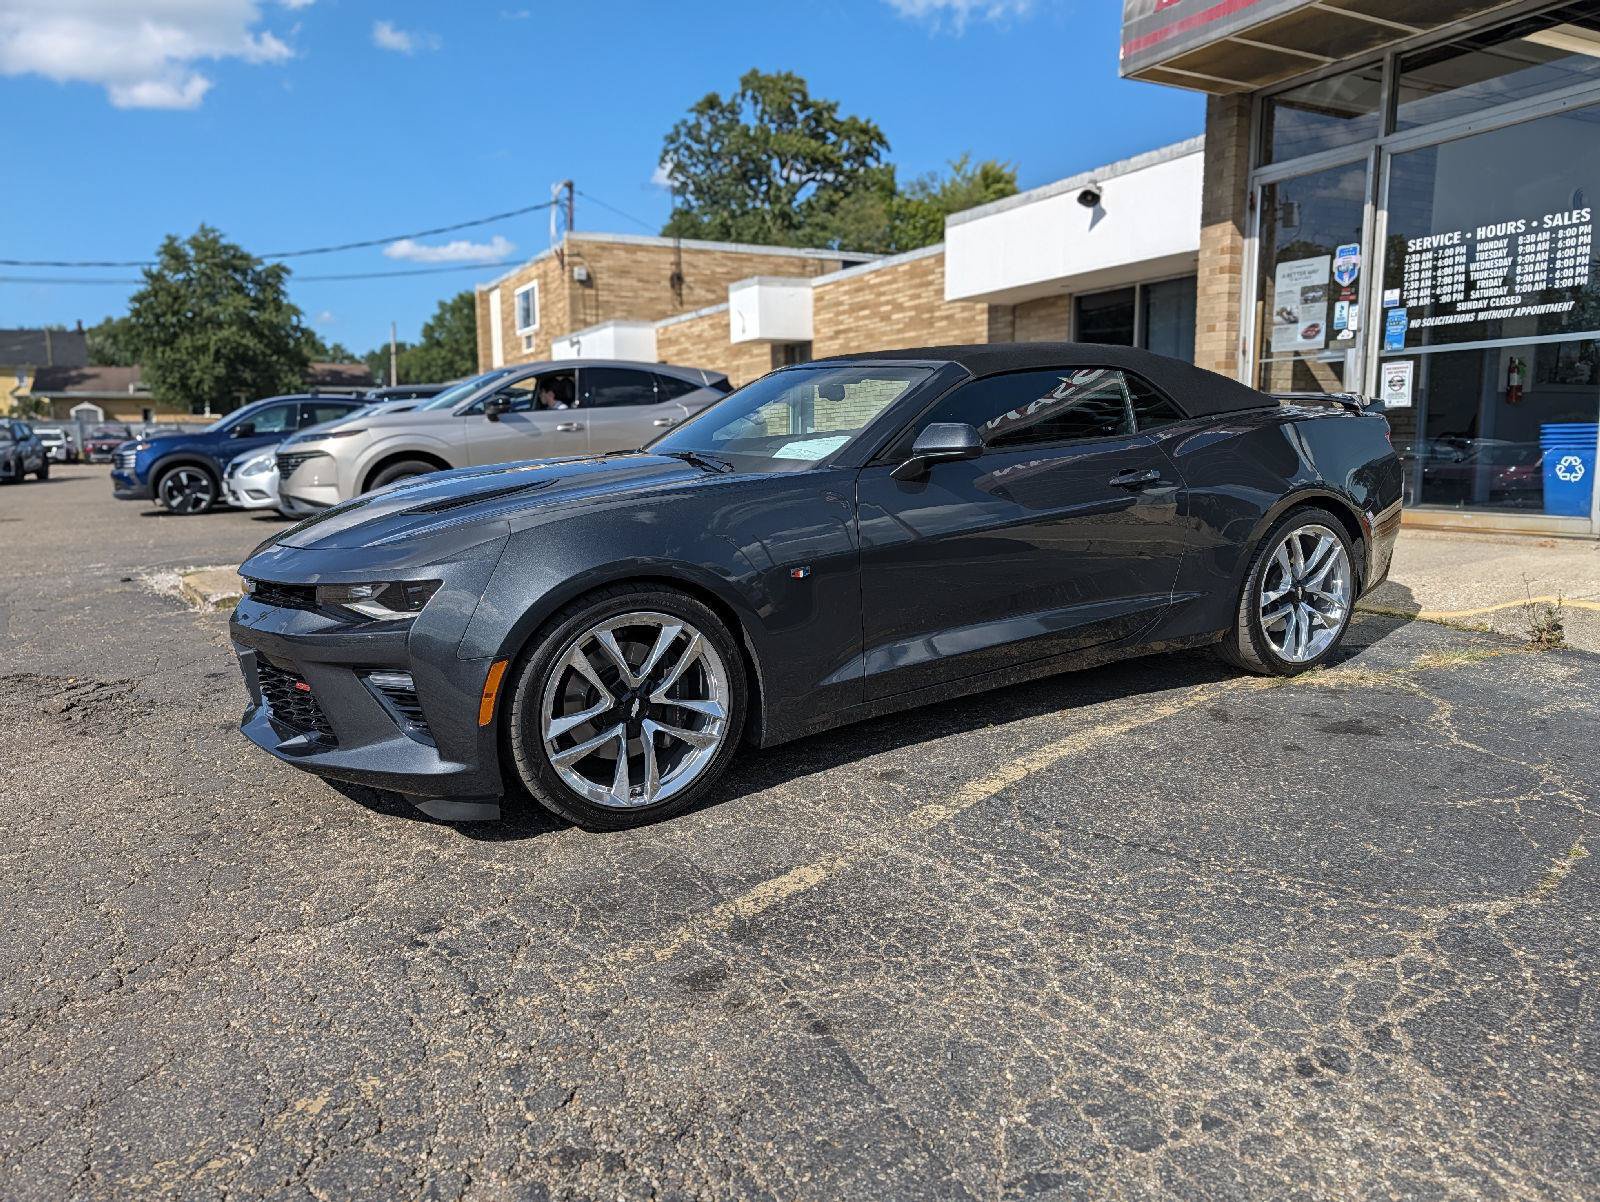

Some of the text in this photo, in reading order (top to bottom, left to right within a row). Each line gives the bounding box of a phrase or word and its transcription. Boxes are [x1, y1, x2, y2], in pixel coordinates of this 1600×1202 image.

[1408, 208, 1591, 252] SERVICE HOURS SALES
[1421, 251, 1433, 260] AM
[1455, 245, 1466, 255] PM
[1476, 238, 1508, 252] MONDAY
[1518, 234, 1536, 244] 8:30
[1536, 231, 1550, 241] AM
[1558, 227, 1577, 238] 8:00
[1579, 224, 1592, 235] PM
[1420, 270, 1432, 279] AM
[1454, 264, 1465, 274] PM
[1470, 257, 1513, 271] WEDNESDAY
[1517, 254, 1535, 264] 9:00
[1535, 252, 1549, 261] AM
[1556, 248, 1575, 258] 6:00
[1577, 245, 1590, 255] PM
[1421, 260, 1432, 269] AM
[1455, 255, 1466, 264] PM
[1475, 248, 1508, 261] TUESDAY
[1518, 244, 1536, 254] 9:00
[1536, 241, 1550, 251] AM
[1557, 237, 1576, 248] 6:00
[1578, 234, 1591, 245] PM
[1419, 288, 1430, 297] AM
[1453, 283, 1464, 292] PM
[1477, 277, 1503, 289] FRIDAY
[1515, 274, 1533, 284] 9:00
[1534, 271, 1547, 281] AM
[1555, 268, 1574, 278] 6:00
[1575, 266, 1589, 276] PM
[1420, 279, 1431, 288] AM
[1454, 274, 1465, 283] PM
[1470, 267, 1508, 281] THURSDAY
[1516, 264, 1534, 274] 8:30
[1534, 261, 1548, 271] AM
[1555, 258, 1574, 268] 8:00
[1576, 255, 1589, 265] PM
[1419, 297, 1430, 306] AM
[1453, 292, 1464, 301] PM
[1470, 286, 1508, 299] SATURDAY
[1515, 283, 1532, 293] 9:00
[1533, 281, 1546, 291] AM
[1554, 278, 1573, 288] 3:00
[1575, 276, 1588, 286] PM
[1456, 296, 1521, 311] SUNDAY CLOSED
[1410, 319, 1421, 328] NO
[1421, 312, 1476, 327] SOLICITATIONS
[1477, 308, 1514, 320] WITHOUT
[1514, 302, 1575, 317] APPOINTMENT
